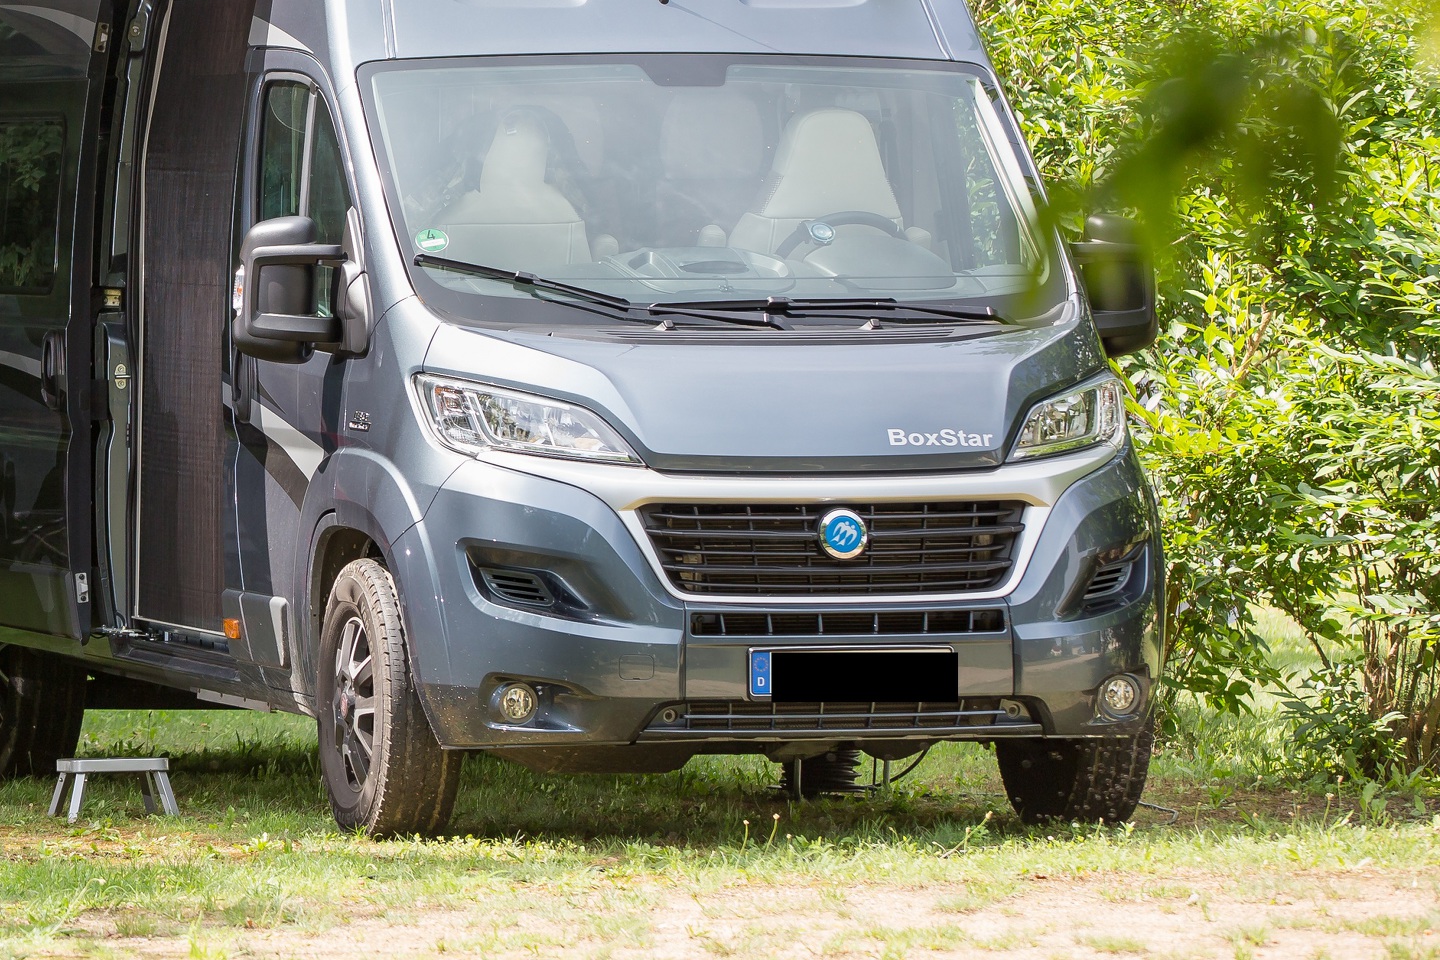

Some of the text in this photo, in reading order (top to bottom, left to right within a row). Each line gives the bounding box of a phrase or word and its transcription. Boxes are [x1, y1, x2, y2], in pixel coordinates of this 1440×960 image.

[427, 230, 436, 239] 4
[887, 429, 993, 447] BoxStar
[757, 677, 765, 687] D
